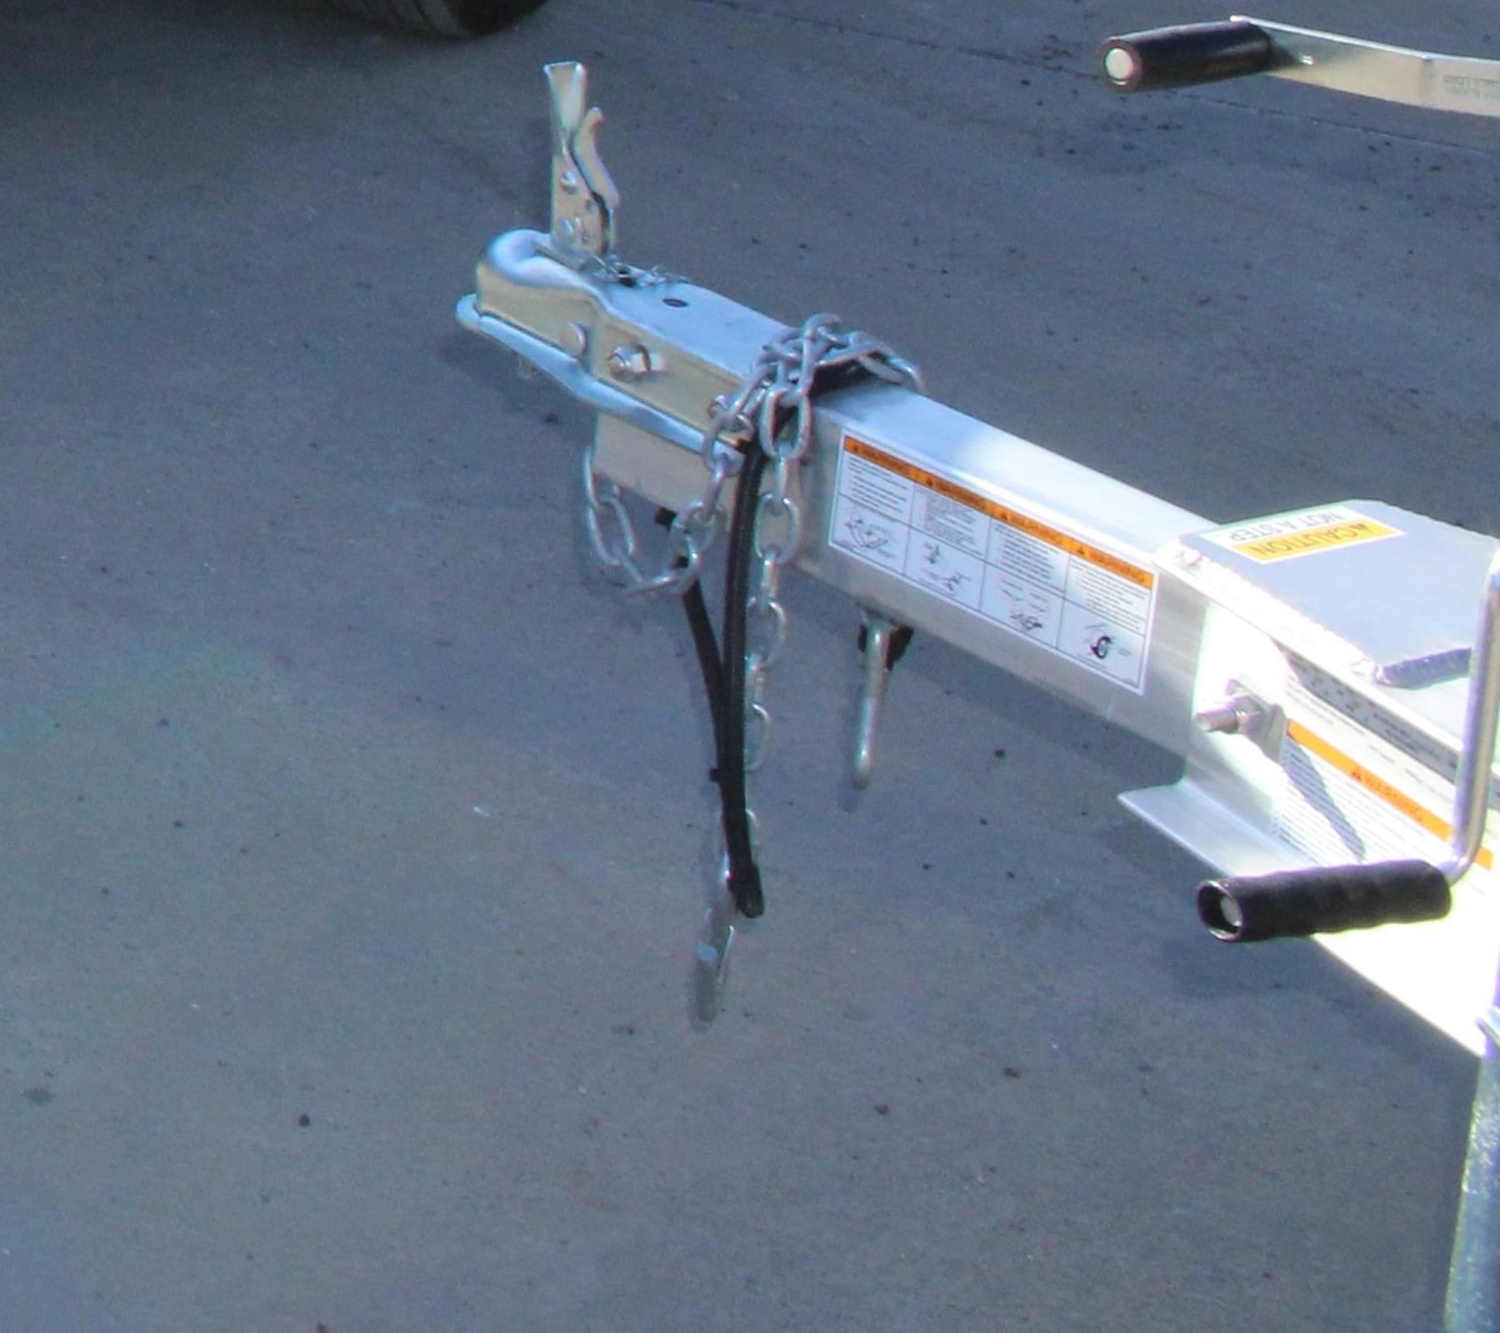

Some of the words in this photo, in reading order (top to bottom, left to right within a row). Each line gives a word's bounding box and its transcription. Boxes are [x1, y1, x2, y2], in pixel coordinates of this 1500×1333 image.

[1299, 511, 1346, 528] NOT
[1228, 524, 1278, 543] STEP
[1250, 525, 1358, 558] CAUTION
